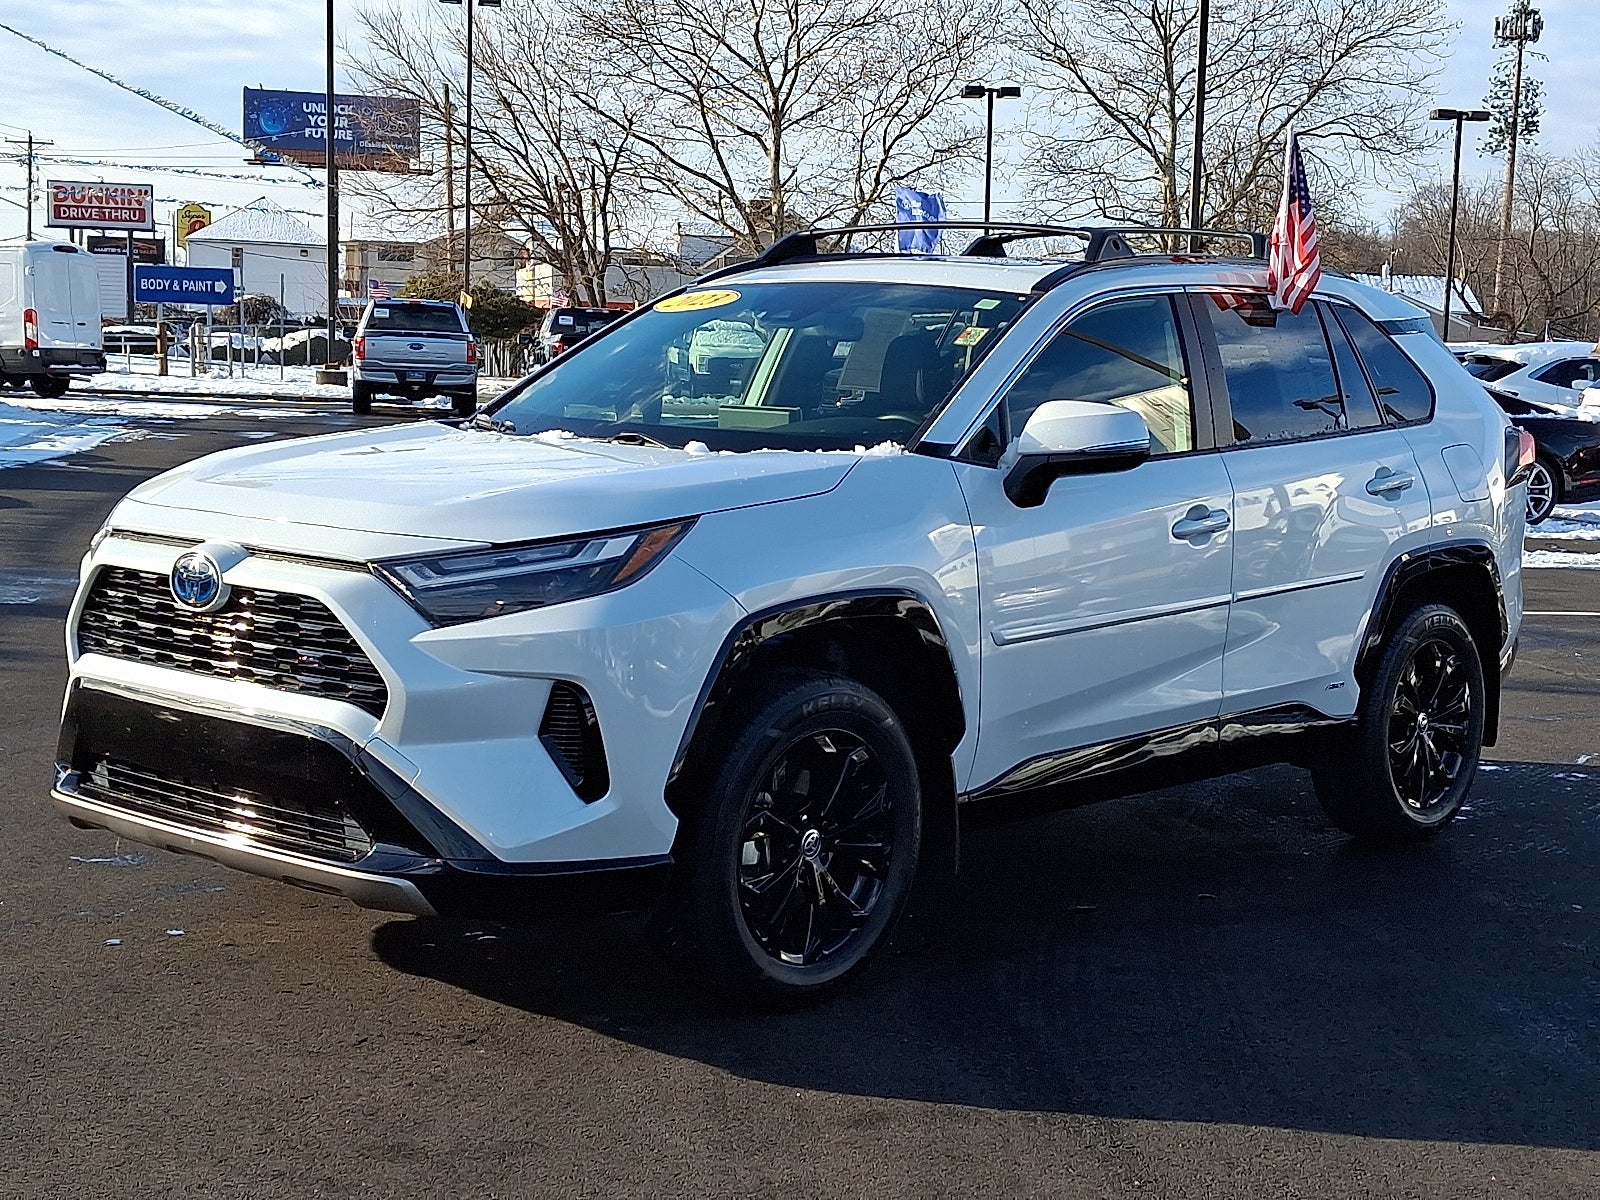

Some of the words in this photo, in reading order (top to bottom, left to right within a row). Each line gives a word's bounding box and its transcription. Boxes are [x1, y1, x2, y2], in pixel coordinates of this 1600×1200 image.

[302, 102, 353, 115] UNLCK
[53, 186, 148, 206] DUNKIN'
[60, 207, 99, 219] DRIVE
[102, 209, 140, 221] THRU
[140, 278, 171, 291] BODY
[172, 280, 180, 291] &
[182, 281, 213, 292] PAINT
[1424, 615, 1457, 631] KELLY
